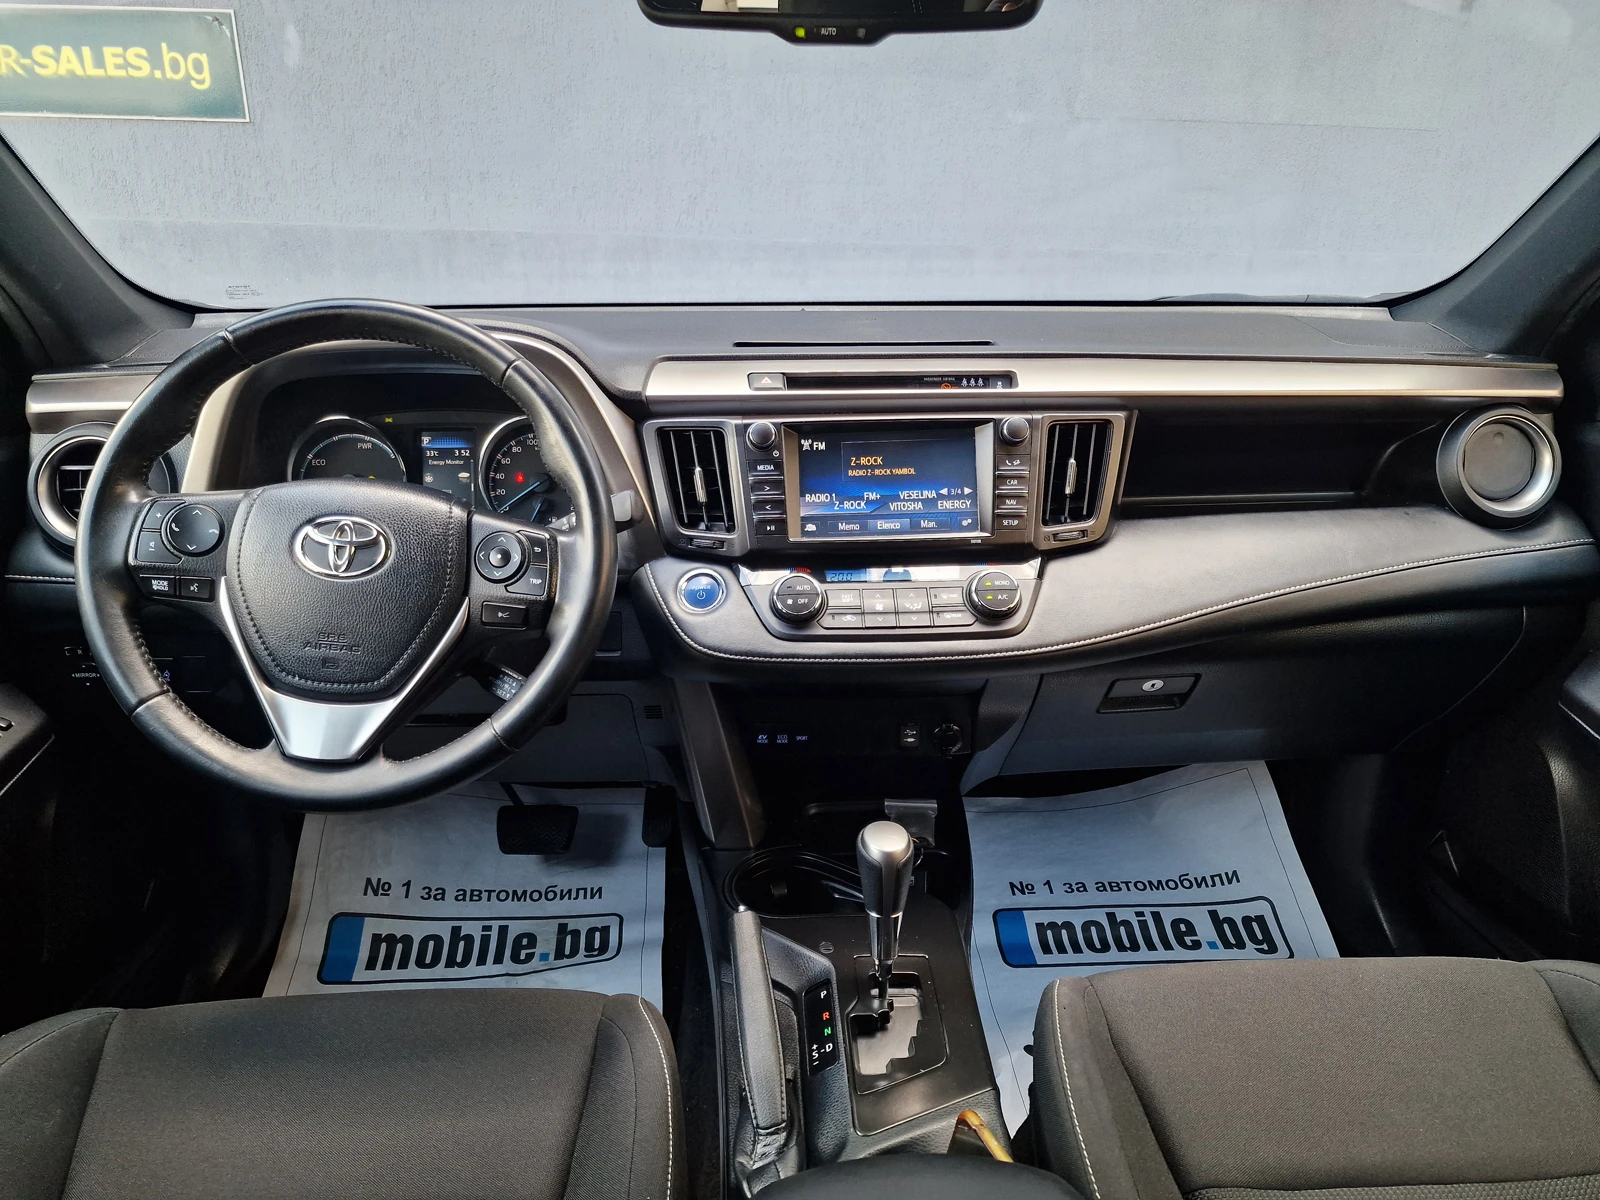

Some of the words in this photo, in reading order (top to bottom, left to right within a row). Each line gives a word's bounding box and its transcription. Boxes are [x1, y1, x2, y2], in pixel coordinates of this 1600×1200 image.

[820, 27, 837, 35] AUTO
[357, 442, 373, 450] PWR
[813, 441, 826, 451] FM
[311, 458, 326, 466] ECO
[850, 456, 883, 466] Z-ROCK
[848, 469, 867, 477] RADIO
[867, 468, 891, 476] Z-ROCK
[891, 467, 916, 475] YAMBOL
[495, 488, 506, 496] 20
[863, 491, 881, 500] FM+
[899, 490, 937, 500] VESELINA
[950, 487, 962, 495] 3/4
[805, 493, 831, 503] RADIO
[831, 493, 836, 502] 1
[834, 500, 867, 510] Z-ROCK
[889, 502, 923, 511] VITOSHA
[937, 500, 972, 510] ENERGY
[838, 522, 860, 532] Memo
[877, 520, 901, 530] Elenco
[920, 519, 938, 529] Man.
[303, 641, 361, 654] AIRBAG
[1042, 879, 1055, 895] 1
[1063, 880, 1089, 894] за
[1095, 869, 1242, 893] автомобили
[401, 879, 412, 899] 1
[420, 886, 446, 902] за
[454, 884, 604, 903] автомобили
[1034, 909, 1280, 956] mobile.bg
[363, 922, 612, 972] mobile.bg
[820, 990, 827, 999] P
[822, 1011, 830, 1021] R
[824, 1026, 832, 1036] N
